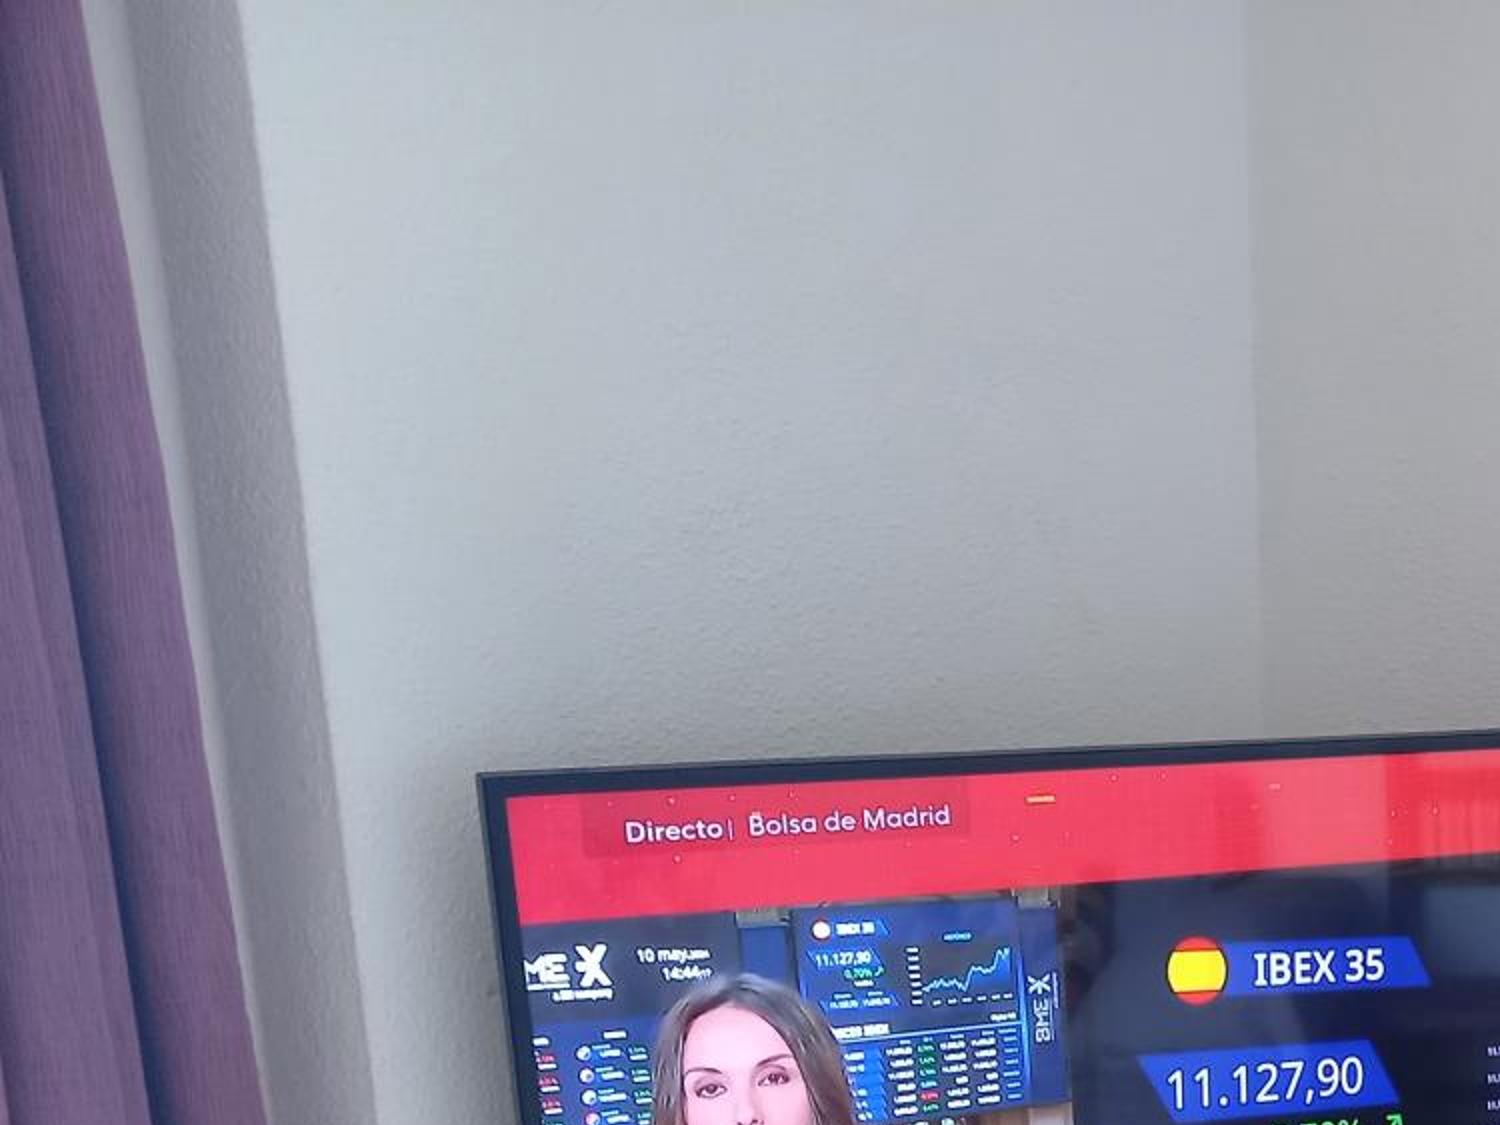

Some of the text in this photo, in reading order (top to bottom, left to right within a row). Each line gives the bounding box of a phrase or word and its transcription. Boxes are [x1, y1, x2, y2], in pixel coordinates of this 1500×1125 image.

[625, 804, 952, 844] Directo Bolsa de Madrid
[1253, 948, 1386, 987] IBEX 35
[1166, 1055, 1365, 1112] 11.127,90
